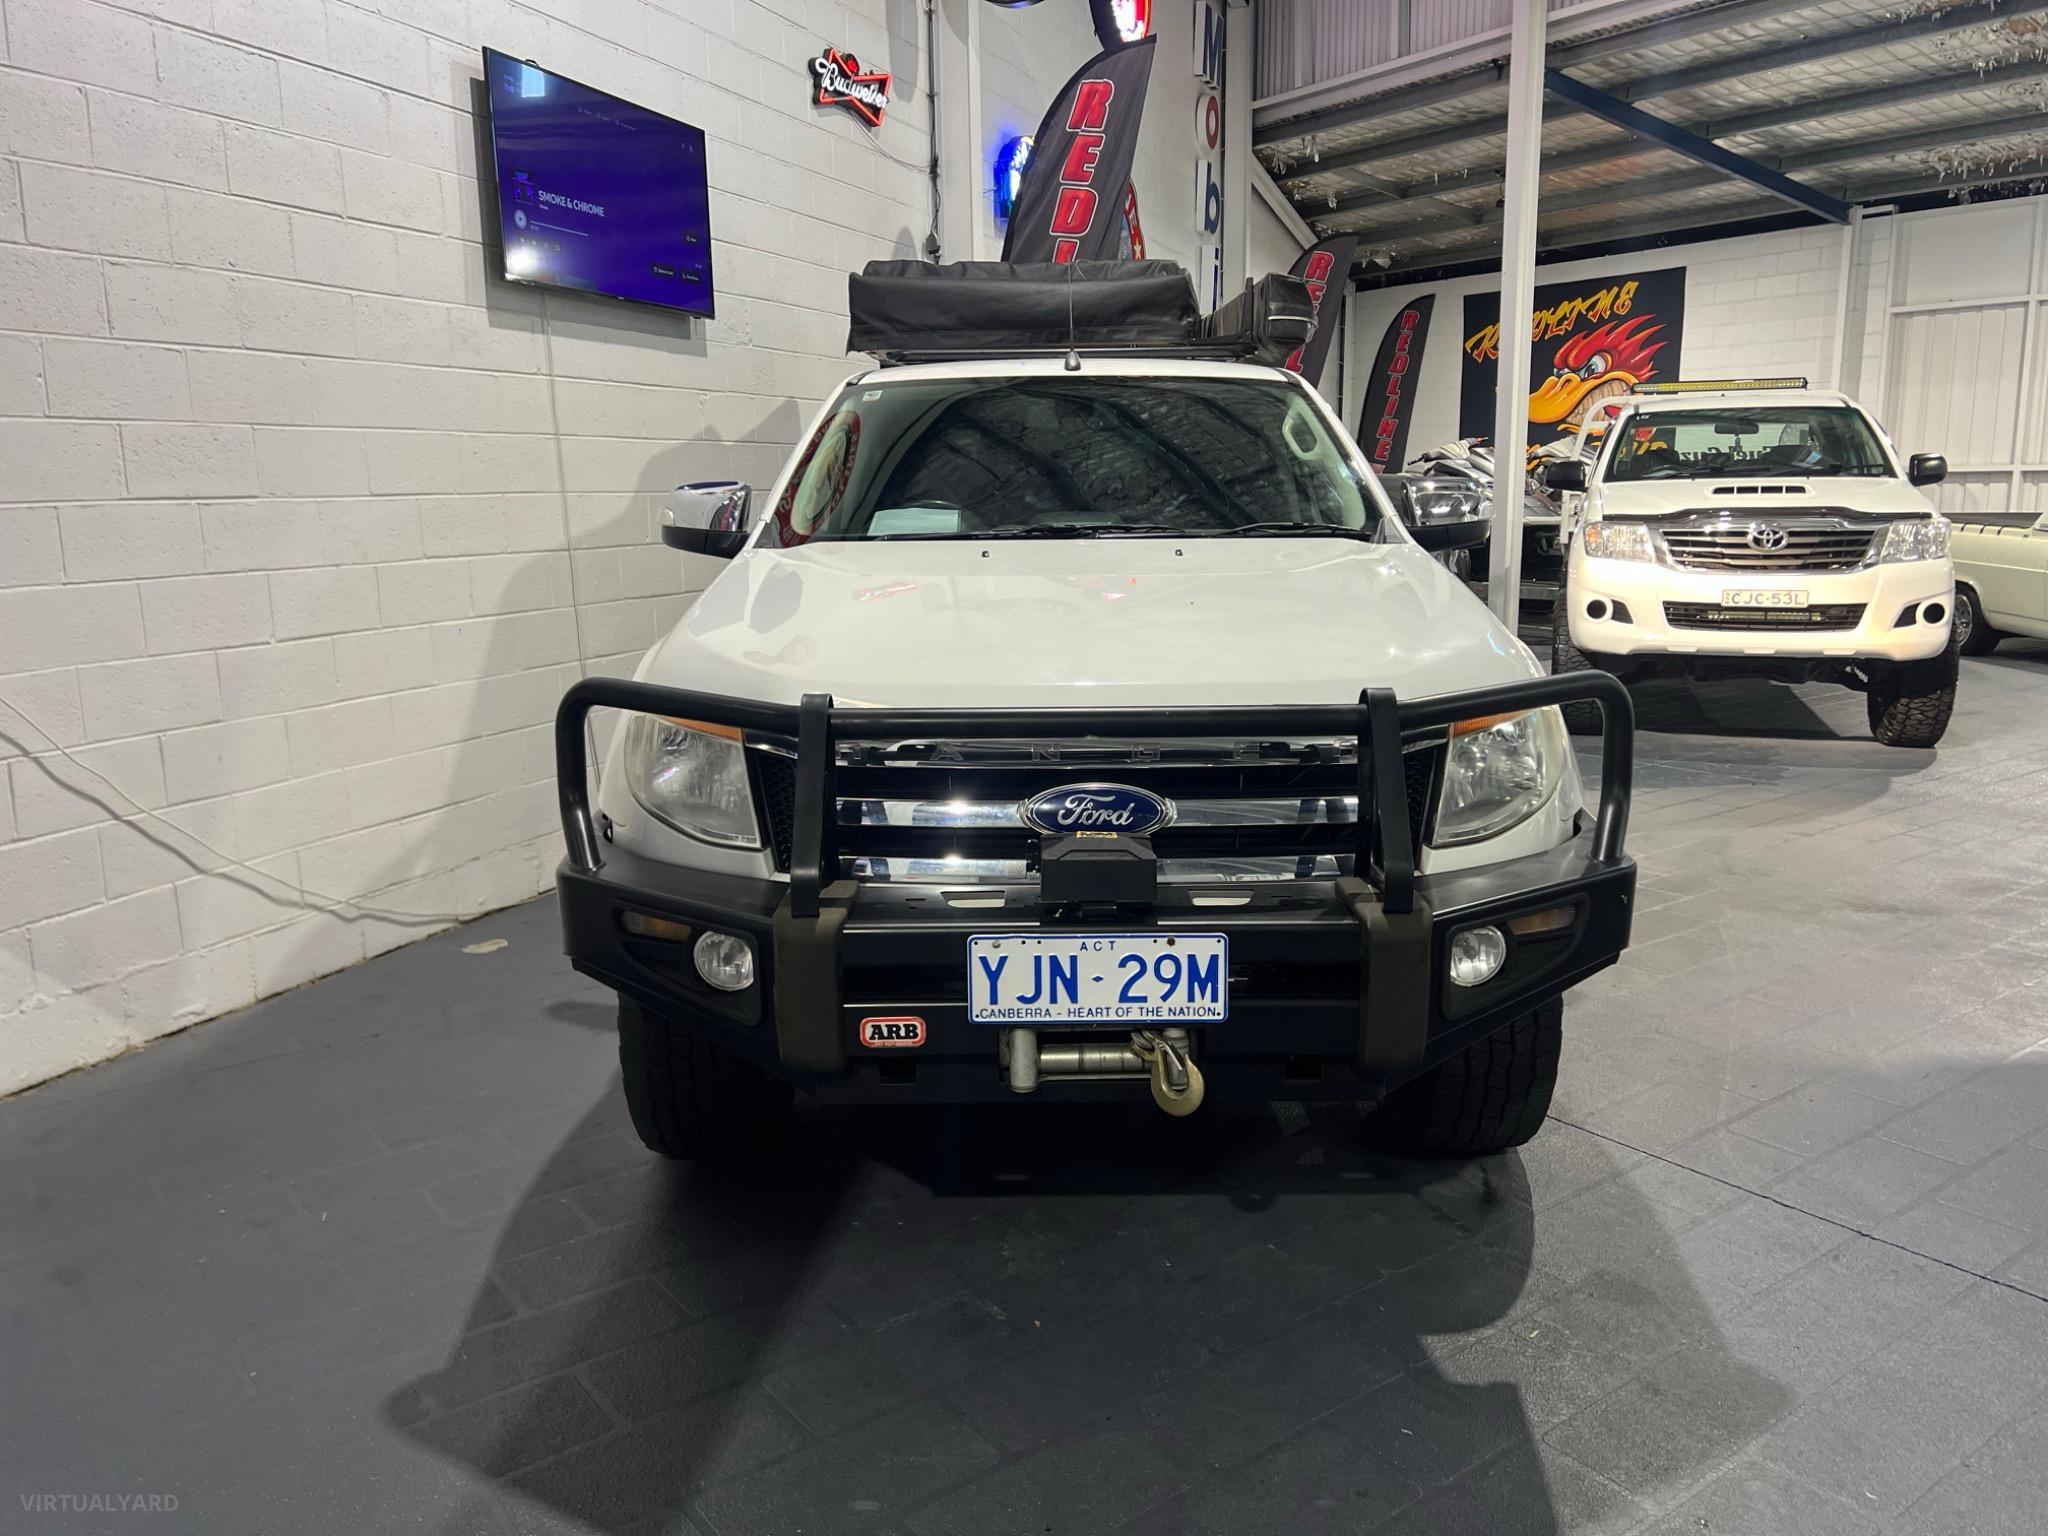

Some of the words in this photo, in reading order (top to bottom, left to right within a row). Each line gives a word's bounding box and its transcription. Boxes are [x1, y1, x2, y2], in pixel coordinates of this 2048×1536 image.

[538, 190, 566, 207] SMOKE
[566, 199, 573, 209] &
[573, 199, 605, 216] CHROME
[1375, 310, 1420, 461] REDLINE
[1057, 794, 1135, 825] Ford
[1080, 941, 1116, 951] ACT
[980, 1008, 1051, 1018] CANBERRA
[1068, 1008, 1110, 1017] HEART
[1115, 1007, 1133, 1017] OF
[1138, 1007, 1163, 1017] THE
[1168, 1006, 1216, 1017] NATION
[869, 1024, 919, 1040] ARB
